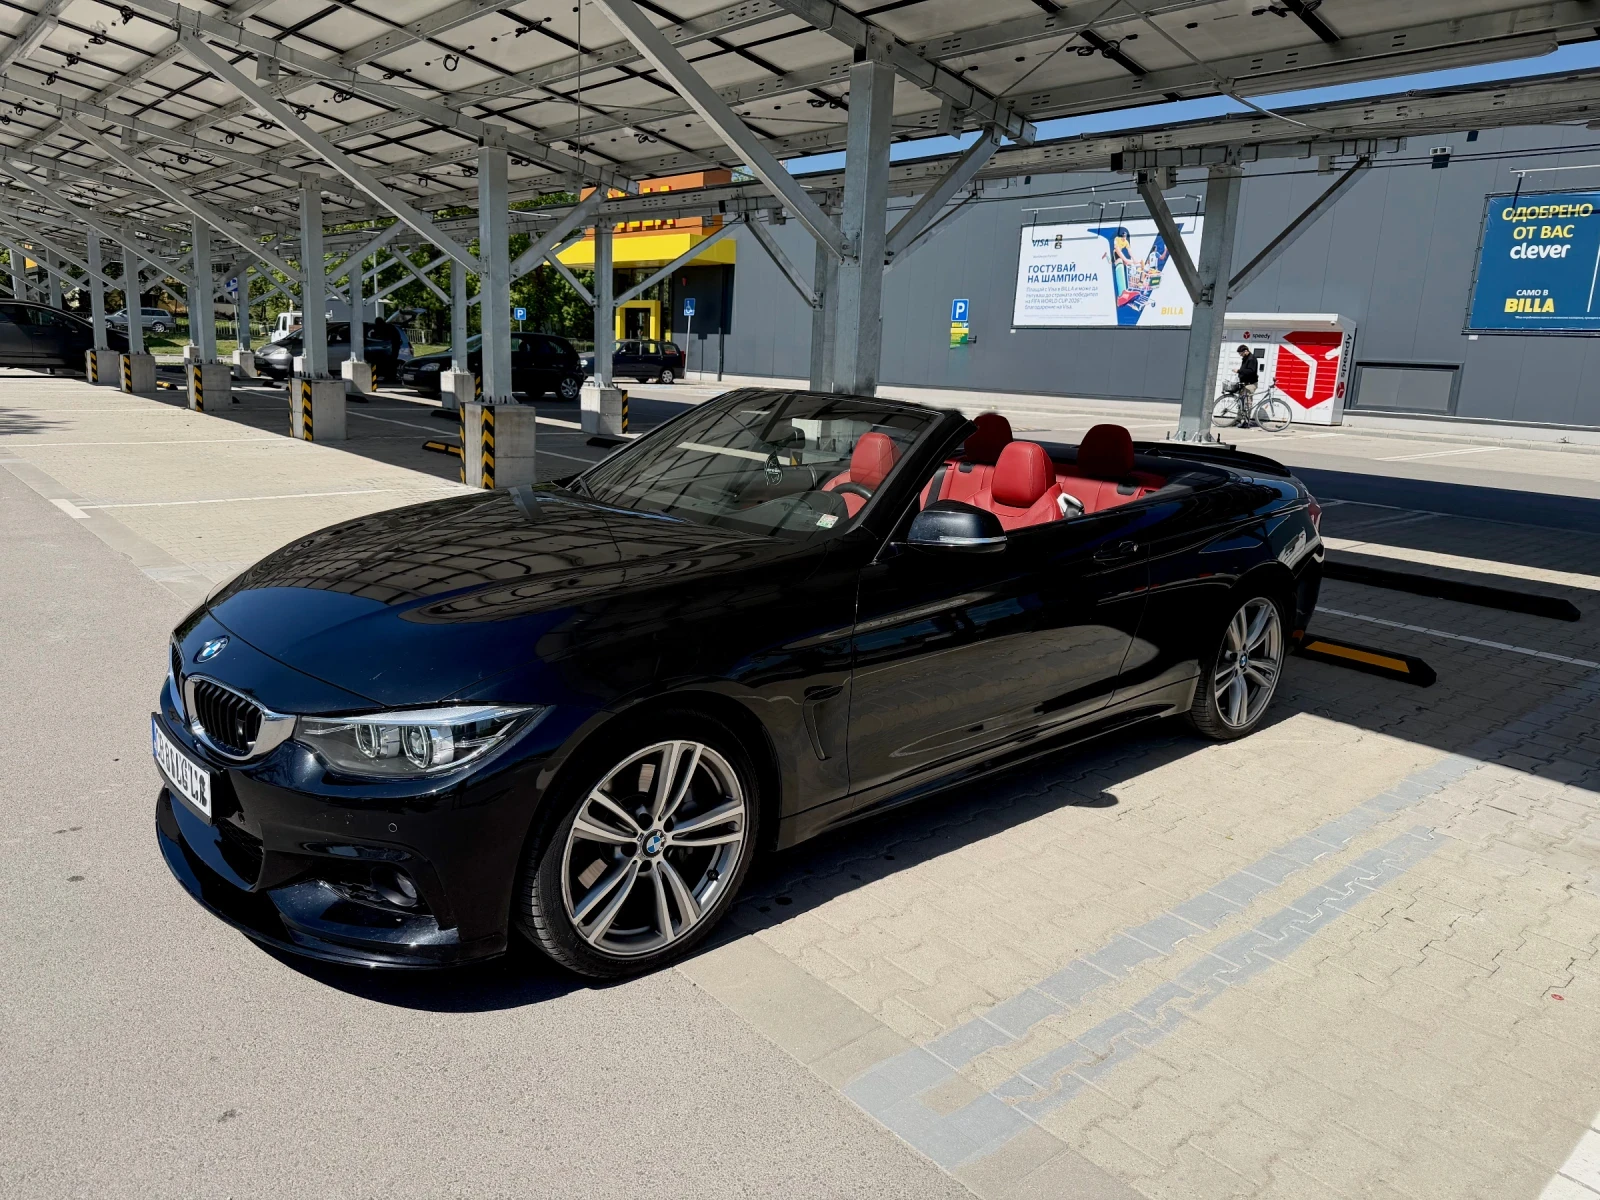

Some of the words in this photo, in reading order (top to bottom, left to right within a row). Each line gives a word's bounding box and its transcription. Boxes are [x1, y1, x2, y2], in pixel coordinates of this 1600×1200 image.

[1502, 203, 1593, 222] ОДОБРЕНО
[1513, 226, 1537, 240] ОТ
[1540, 225, 1574, 239] ВАС
[1032, 239, 1049, 247] VISA
[1510, 242, 1571, 260] clever
[1028, 261, 1076, 274] ГОСТУВАЙ
[1027, 274, 1040, 283] НА
[1041, 272, 1098, 283] ШАМПИОНА
[955, 302, 965, 319] P
[1161, 306, 1184, 316] BILLA
[1504, 298, 1555, 313] BILLA
[517, 309, 524, 319] P
[1252, 332, 1271, 340] speedy
[1341, 333, 1353, 378] speedy
